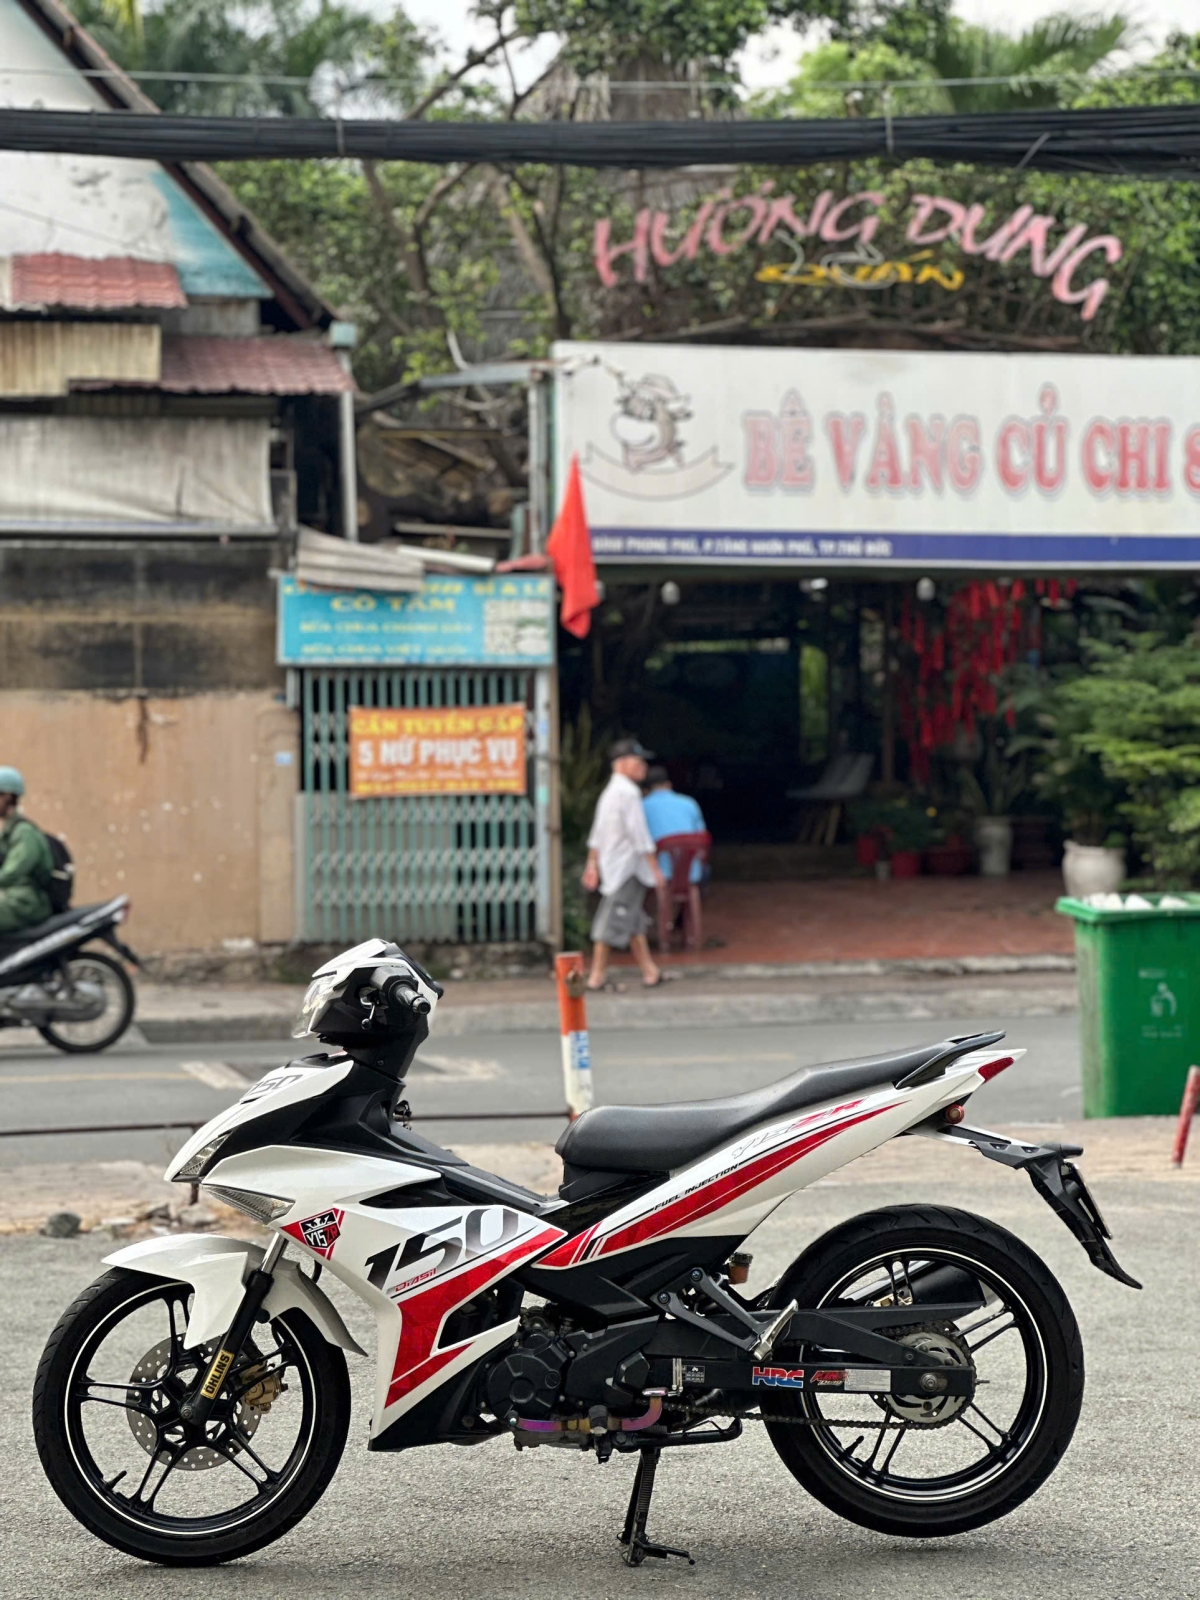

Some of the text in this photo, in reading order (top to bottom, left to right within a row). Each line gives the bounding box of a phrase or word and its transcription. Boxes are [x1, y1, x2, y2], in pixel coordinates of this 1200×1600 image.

[906, 194, 1122, 321] DUNG
[996, 382, 1070, 494] CỦ
[1081, 415, 1173, 496] CHI
[654, 1163, 739, 1211] FUEL INJECTION
[364, 1208, 519, 1291] 150
[752, 1366, 804, 1389] HRC
